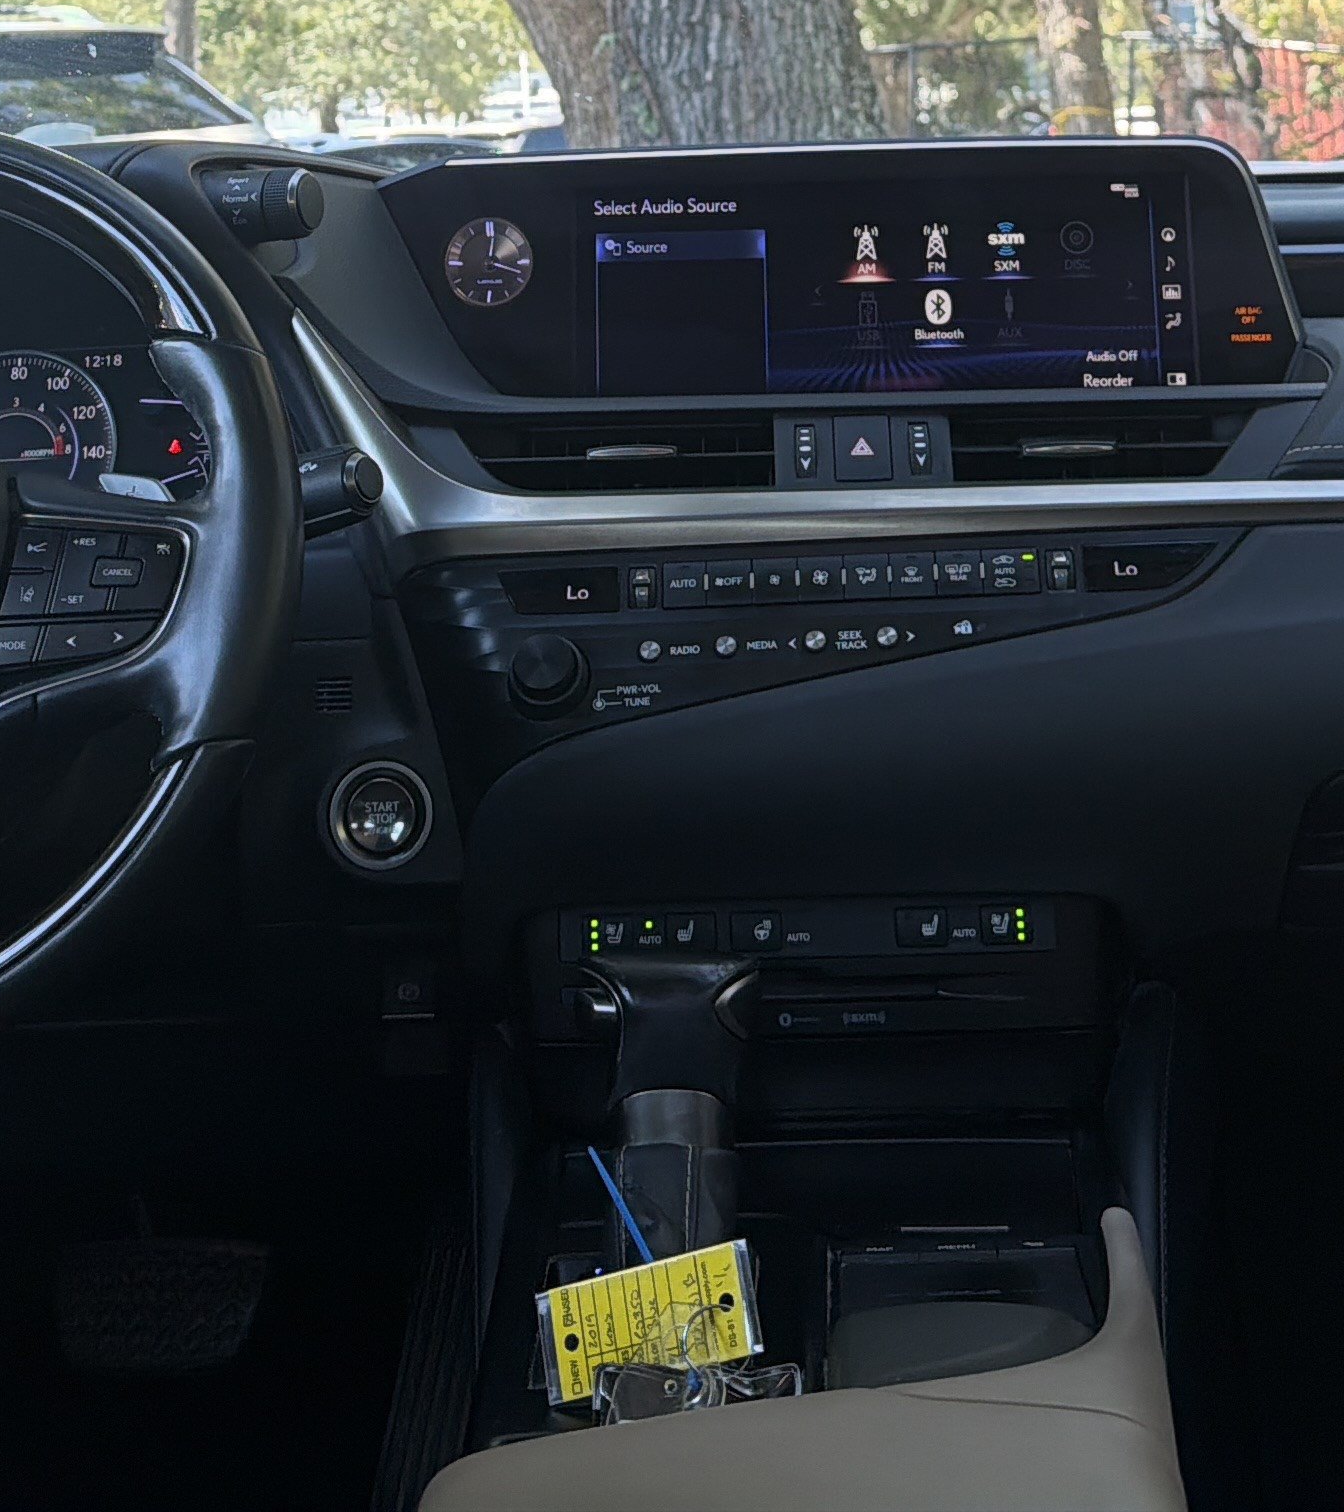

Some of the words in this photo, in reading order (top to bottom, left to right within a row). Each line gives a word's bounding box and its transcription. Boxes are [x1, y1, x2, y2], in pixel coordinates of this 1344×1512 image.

[222, 193, 249, 204] Normal
[593, 199, 637, 216] Select
[640, 197, 684, 215] Audio
[687, 197, 738, 214] Source
[987, 232, 1026, 246] sxm
[626, 240, 669, 255] Source
[856, 262, 877, 275] AM
[927, 261, 946, 274] FM
[994, 259, 1020, 273] SXM
[1064, 258, 1093, 271] DISC
[1241, 315, 1256, 325] OFF
[913, 327, 965, 342] Bluetooth
[997, 326, 1023, 338] AUX
[1230, 334, 1273, 343] PASSENGER
[84, 354, 123, 368] 12:18
[1085, 349, 1117, 363] Audio
[1119, 349, 1139, 362] Off
[10, 367, 28, 381] 80
[1083, 372, 1134, 387] Reorder
[46, 376, 71, 391] 100
[13, 397, 21, 408] 3
[37, 403, 45, 413] 4
[72, 405, 97, 420] 120
[58, 423, 66, 433] 6
[64, 445, 72, 455] 8
[81, 446, 106, 460] 140
[102, 568, 133, 577] CANCEL
[994, 567, 1016, 576] AUTO
[1113, 560, 1139, 577] Lo
[669, 578, 697, 589] AUTO
[724, 576, 744, 587] OFF
[900, 575, 924, 584] FRONT
[566, 584, 590, 601] Lo
[837, 630, 863, 640] SEEK
[746, 640, 779, 651] MEDIA
[834, 639, 868, 650] TRACK
[669, 645, 701, 656] RADIO
[623, 697, 651, 707] TUNE
[364, 800, 400, 813] START
[367, 813, 396, 824] STOP
[786, 932, 811, 943] AUTO
[952, 928, 977, 938] AUTO
[638, 935, 663, 945] AUTO
[585, 1313, 598, 1348] 2019
[568, 1359, 580, 1382] NEW
